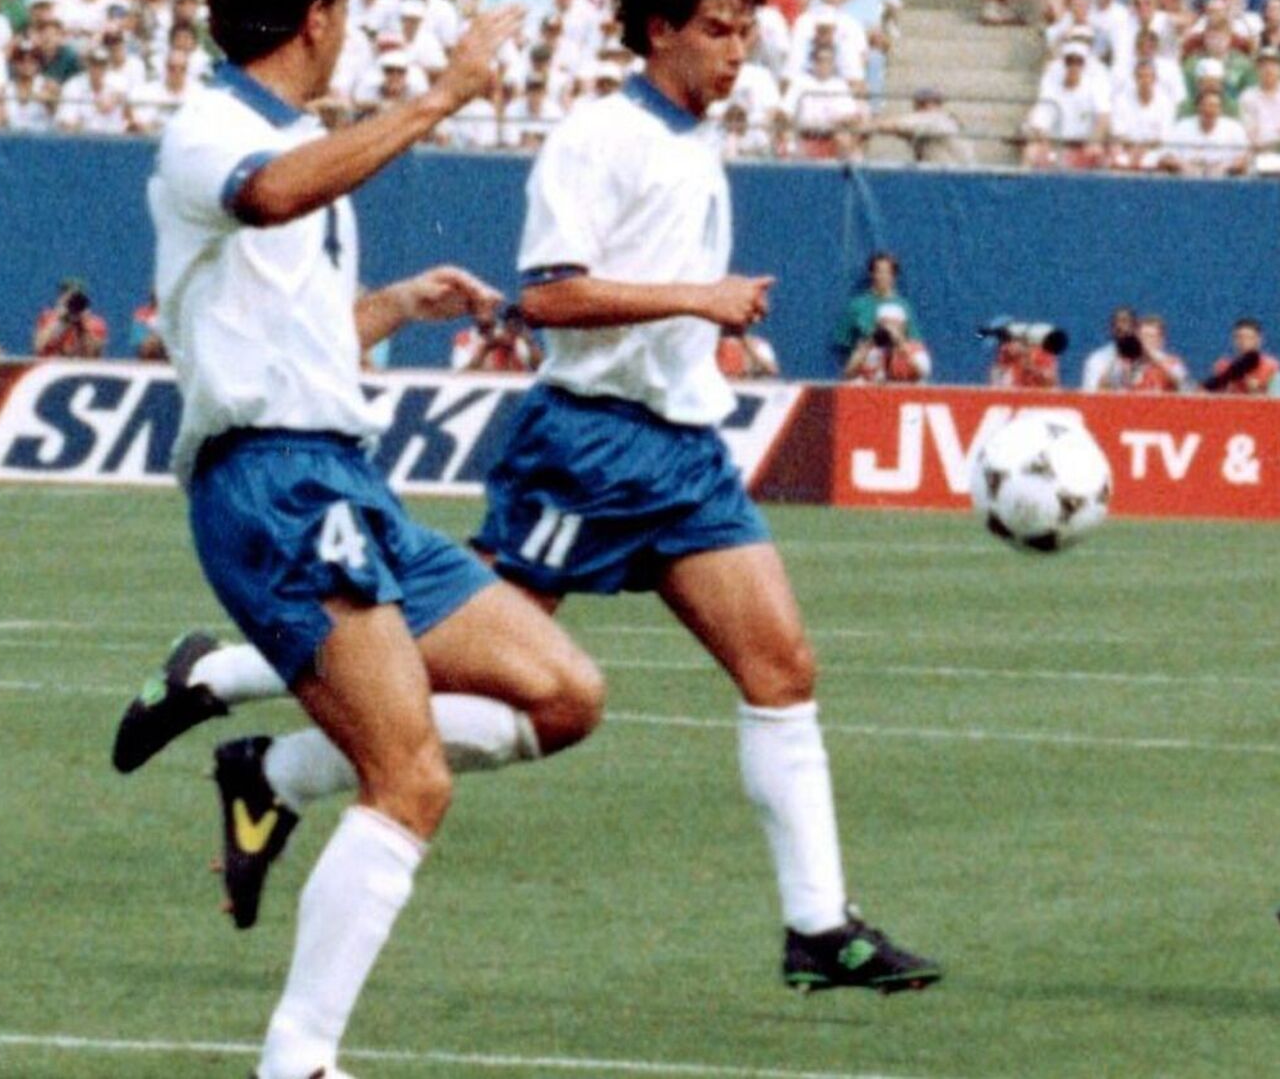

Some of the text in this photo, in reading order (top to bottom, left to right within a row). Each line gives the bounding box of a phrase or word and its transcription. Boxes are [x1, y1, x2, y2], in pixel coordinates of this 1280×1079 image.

[852, 403, 1086, 493] JV
[1120, 430, 1202, 481] TV
[1222, 433, 1261, 485] &
[318, 500, 367, 569] 4
[520, 506, 583, 568] 11
